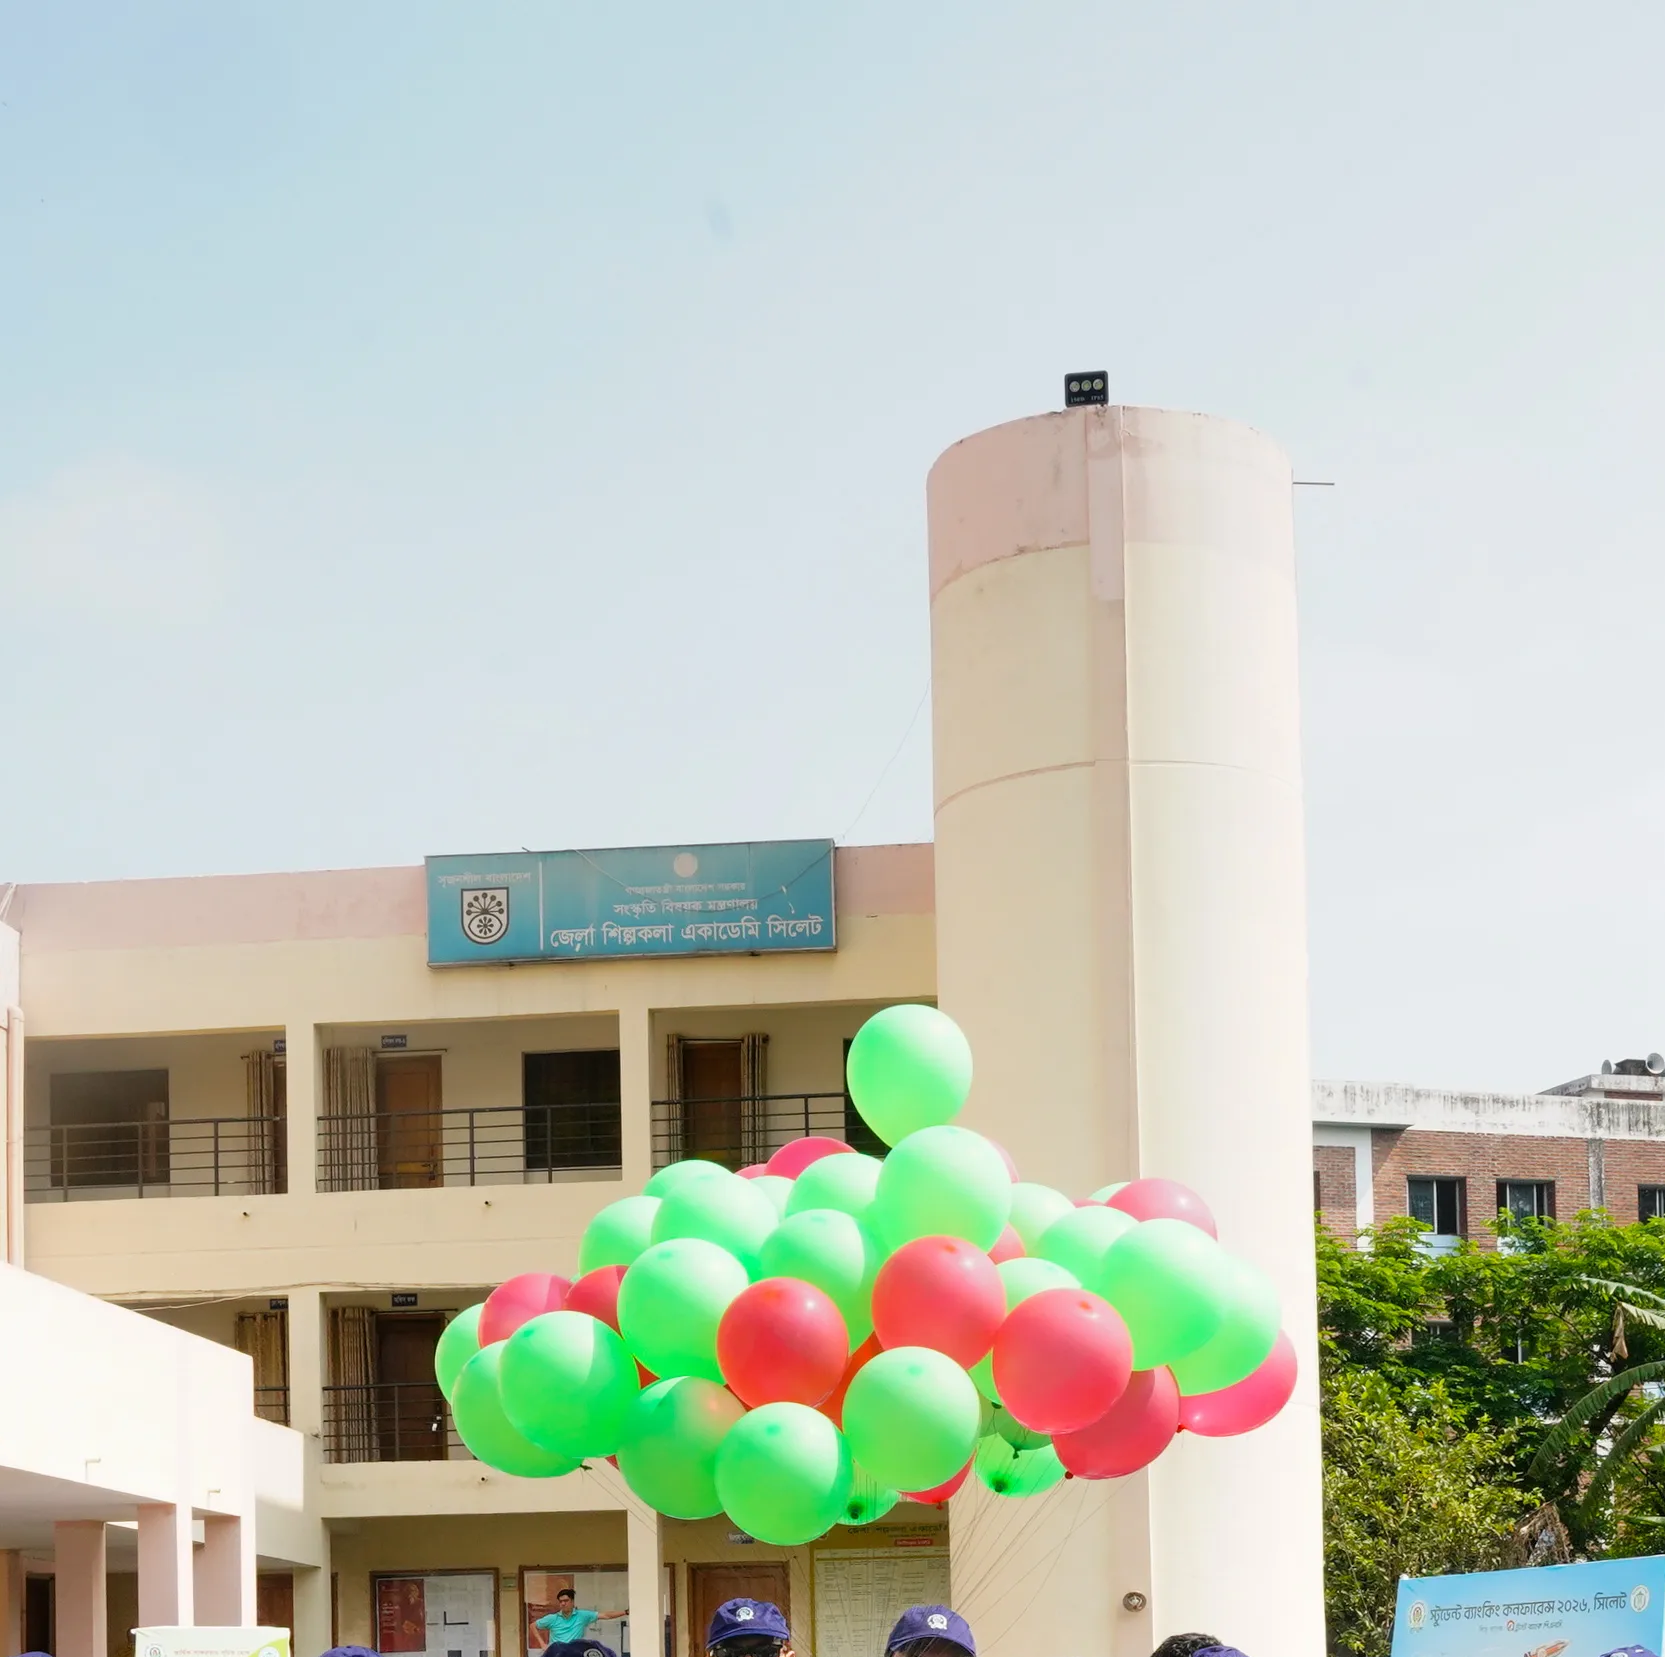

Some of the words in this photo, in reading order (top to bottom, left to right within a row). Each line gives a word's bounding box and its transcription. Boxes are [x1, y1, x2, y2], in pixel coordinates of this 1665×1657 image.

[550, 925, 596, 947] জেলা
[601, 921, 675, 946] শিল্পকলা
[681, 916, 762, 942] একাডেমি
[766, 914, 824, 938] সিলেট
[1430, 1605, 1462, 1627] স্টুডেন্ট
[1464, 1601, 1500, 1619] ব্যাংকিং
[1502, 1600, 1555, 1616] কনফারেন্স
[1594, 1592, 1627, 1610] সিলেট
